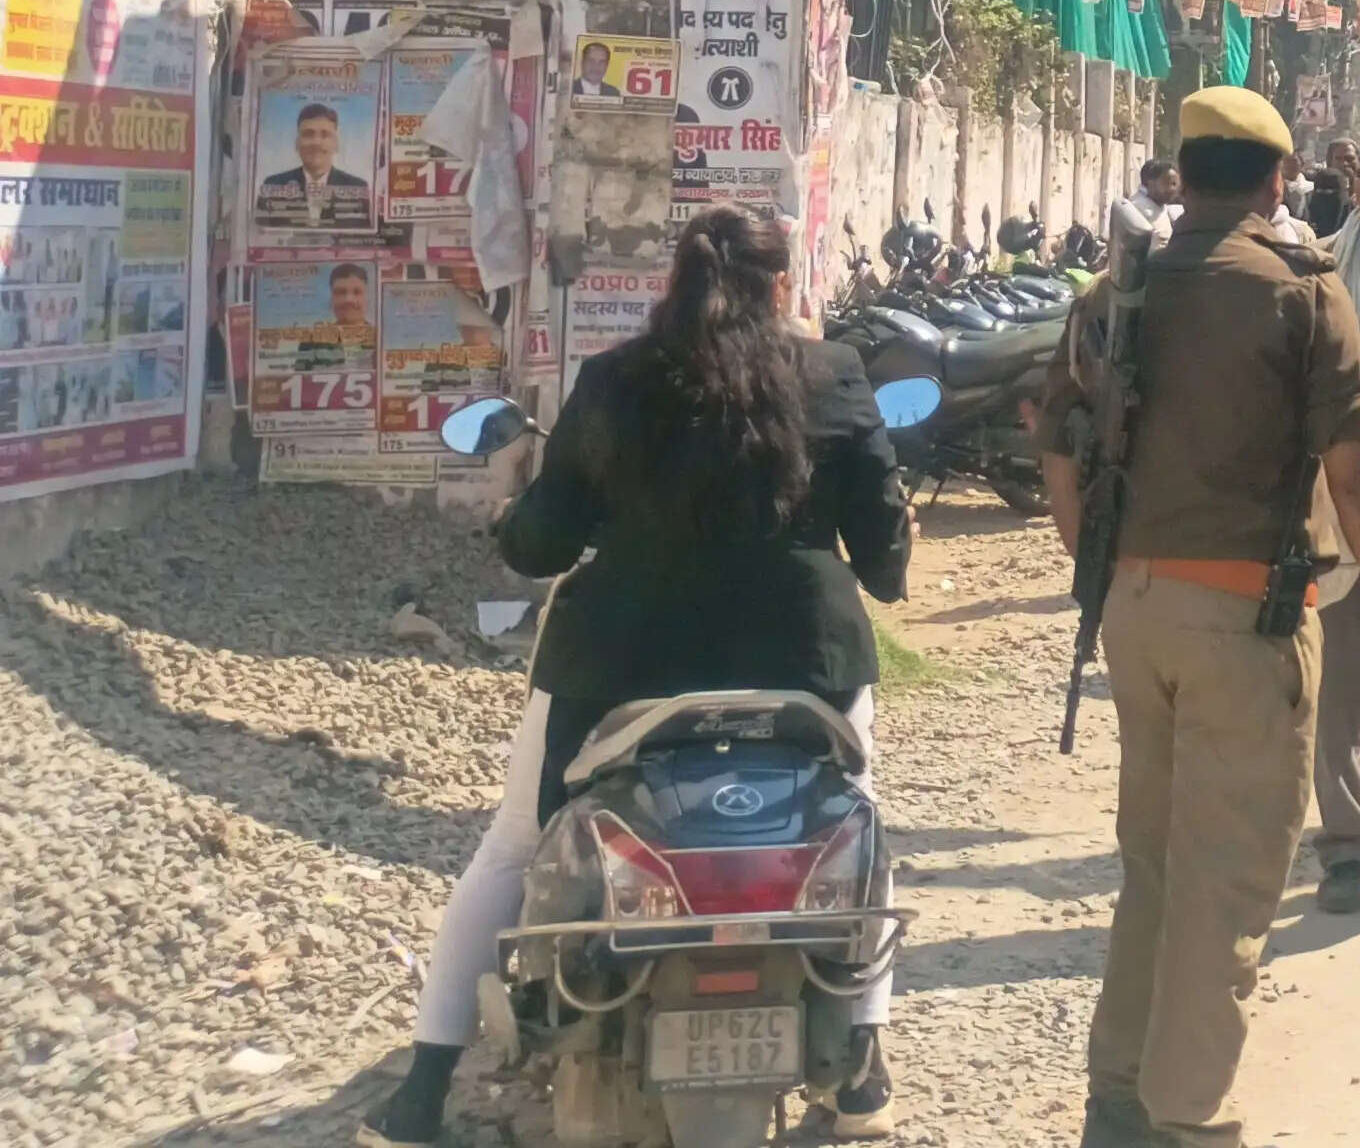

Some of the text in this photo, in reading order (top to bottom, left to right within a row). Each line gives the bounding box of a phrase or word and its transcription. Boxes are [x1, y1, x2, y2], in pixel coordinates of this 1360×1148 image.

[694, 31, 760, 60] त्याशी
[627, 67, 672, 96] 61
[741, 118, 782, 151] सिंह
[281, 373, 372, 409] 175
[687, 1010, 784, 1042] UP62C
